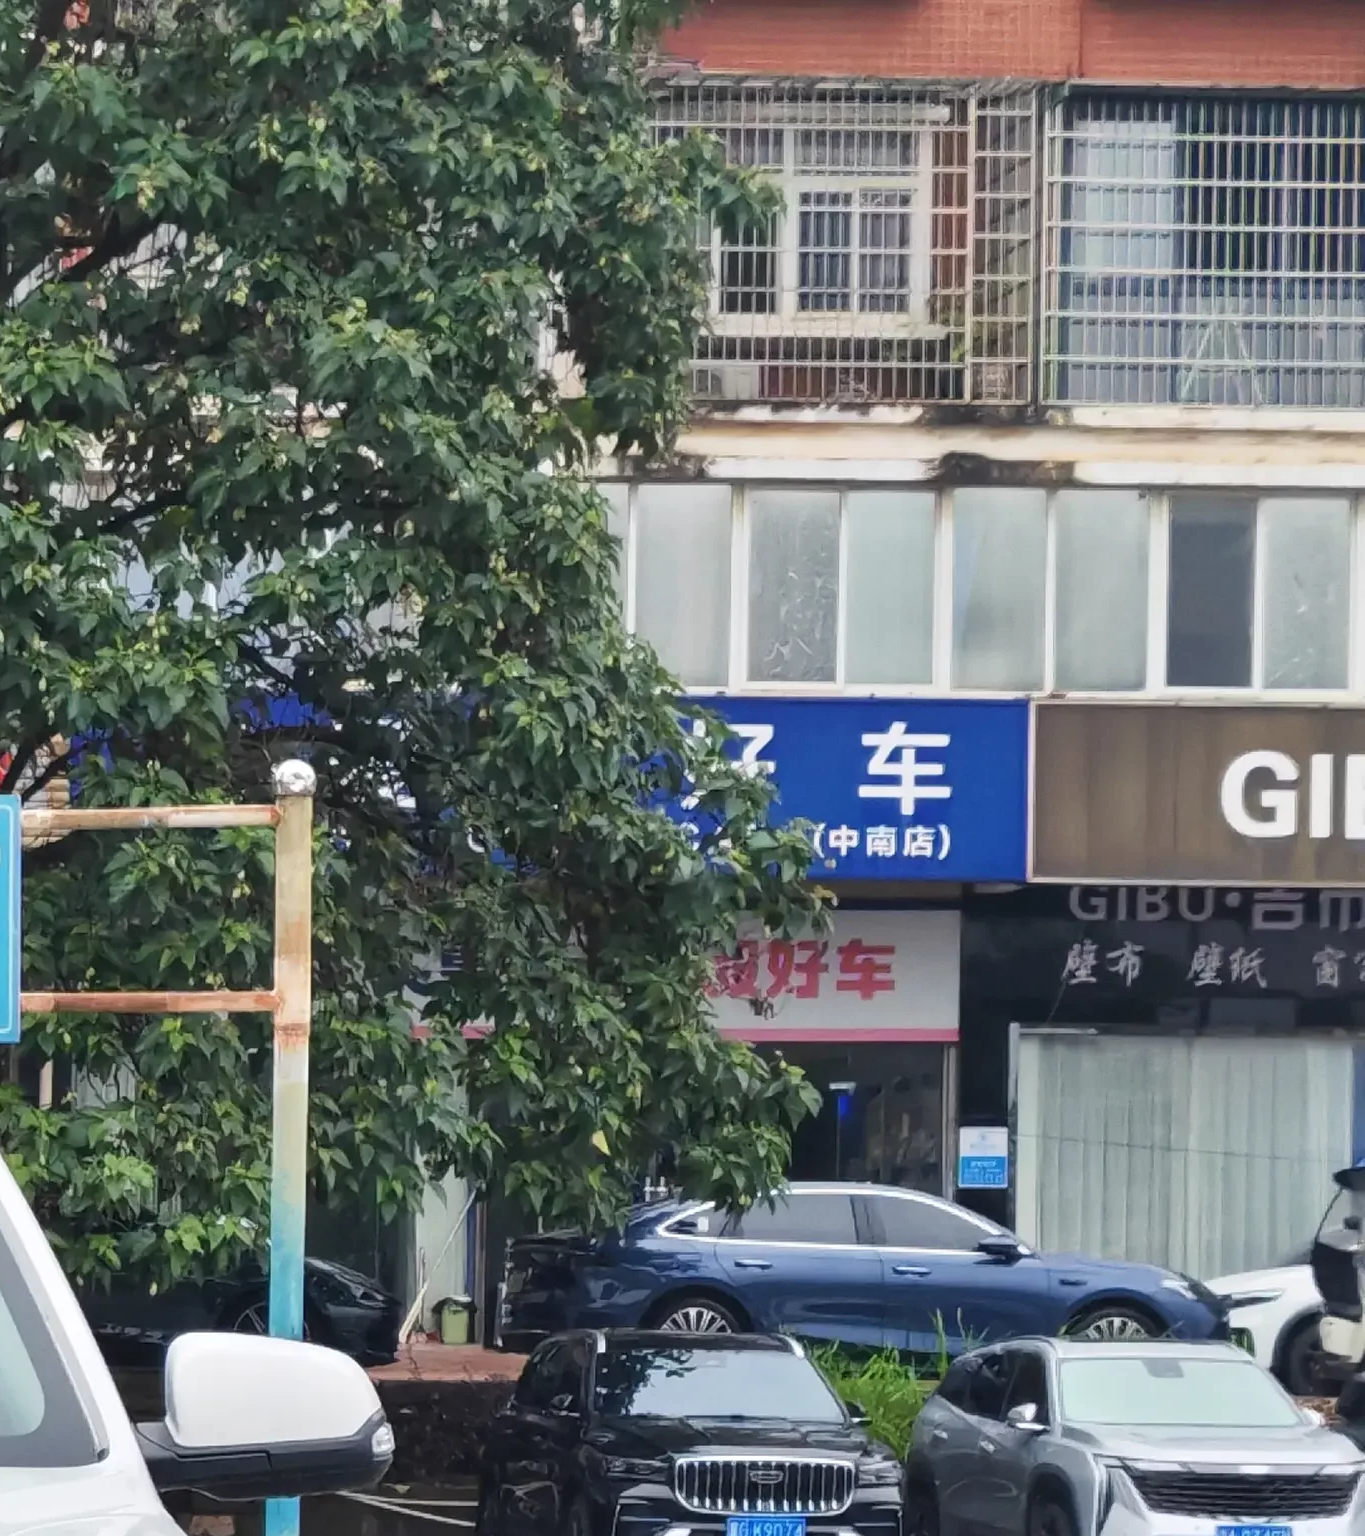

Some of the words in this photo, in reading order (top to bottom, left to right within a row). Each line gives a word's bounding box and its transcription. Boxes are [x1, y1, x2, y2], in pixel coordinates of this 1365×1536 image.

[1221, 750, 1365, 840] GI
[1062, 938, 1145, 988] 壁布
[1185, 941, 1269, 989] 壁纸
[1312, 944, 1365, 989] 窗
